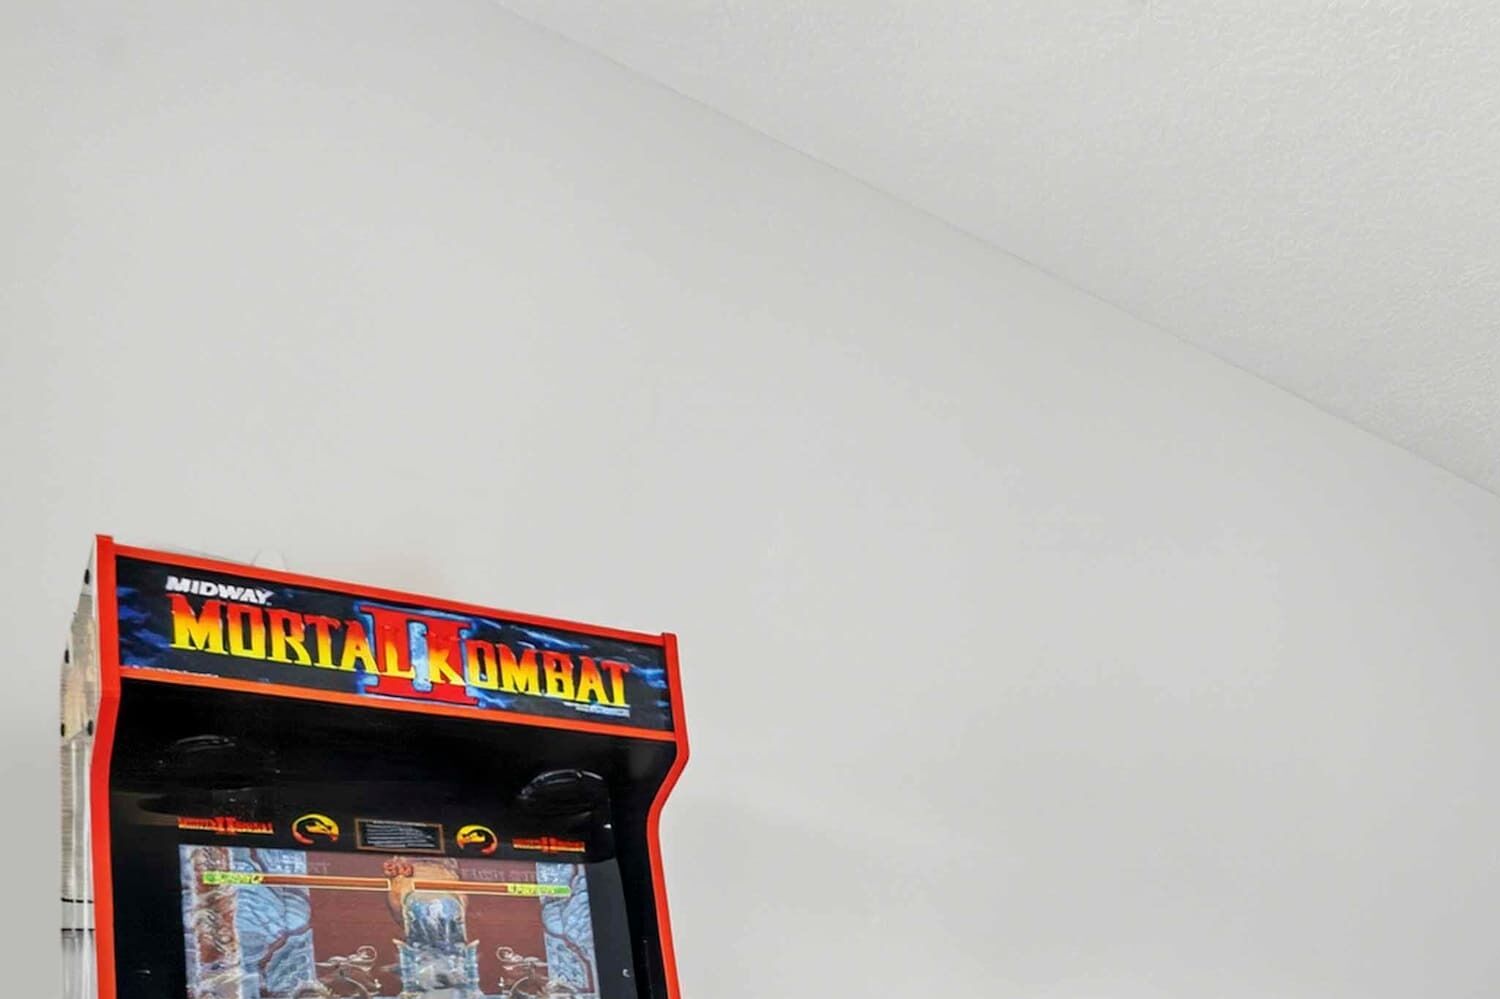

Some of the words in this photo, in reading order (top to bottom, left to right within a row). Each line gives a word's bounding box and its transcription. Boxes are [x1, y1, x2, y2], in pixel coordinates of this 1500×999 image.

[165, 575, 274, 604] MIDWAY
[166, 593, 416, 679] MORTAL
[426, 630, 630, 707] KOMBAT
